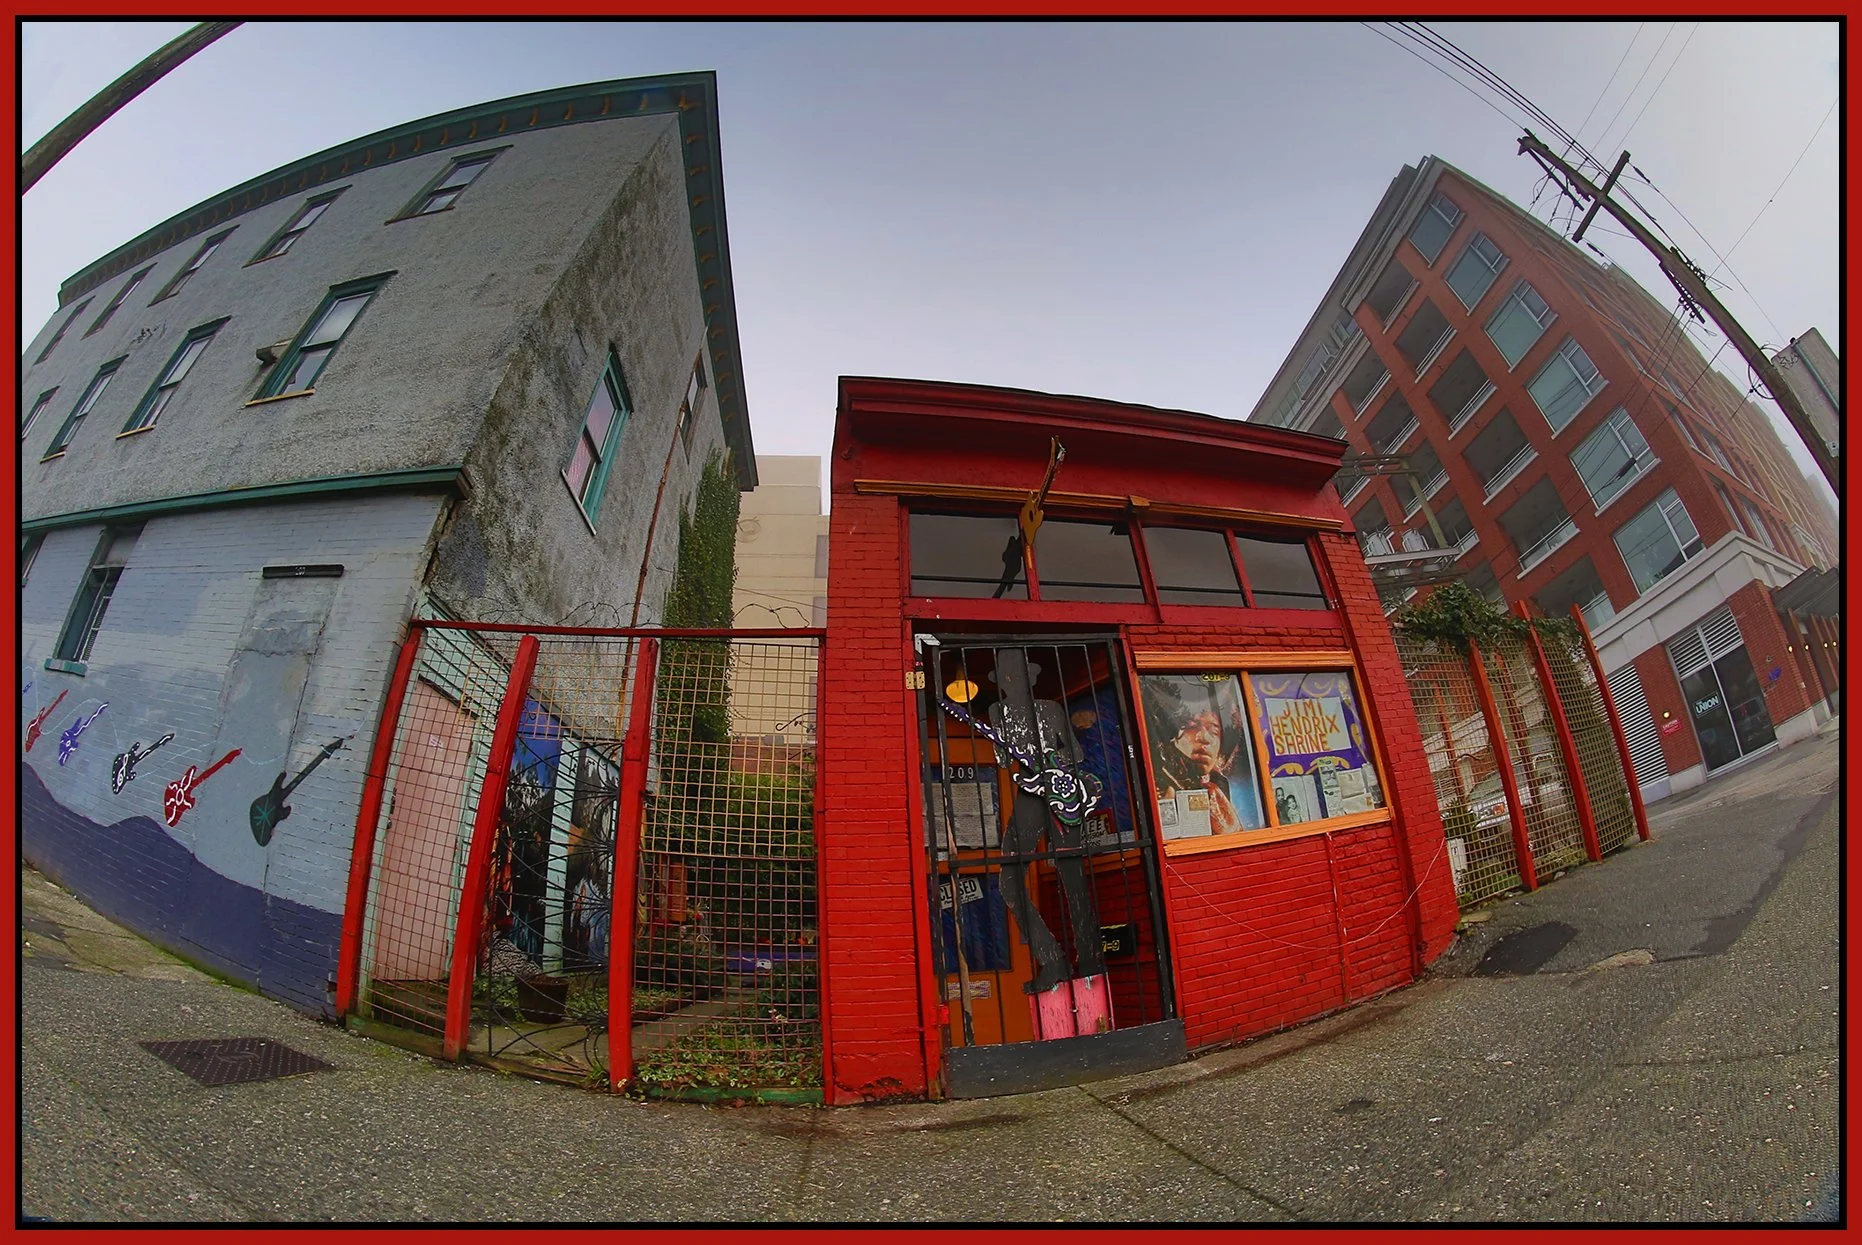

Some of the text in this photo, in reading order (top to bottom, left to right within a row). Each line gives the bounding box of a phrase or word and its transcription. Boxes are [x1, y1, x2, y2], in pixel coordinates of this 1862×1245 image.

[1282, 699, 1323, 719] JIMI
[1695, 695, 1719, 714] UNION
[1269, 714, 1340, 737] HENDRIX
[1274, 733, 1331, 754] SHRINE
[948, 766, 974, 779] 209
[939, 879, 977, 901] CLSED
